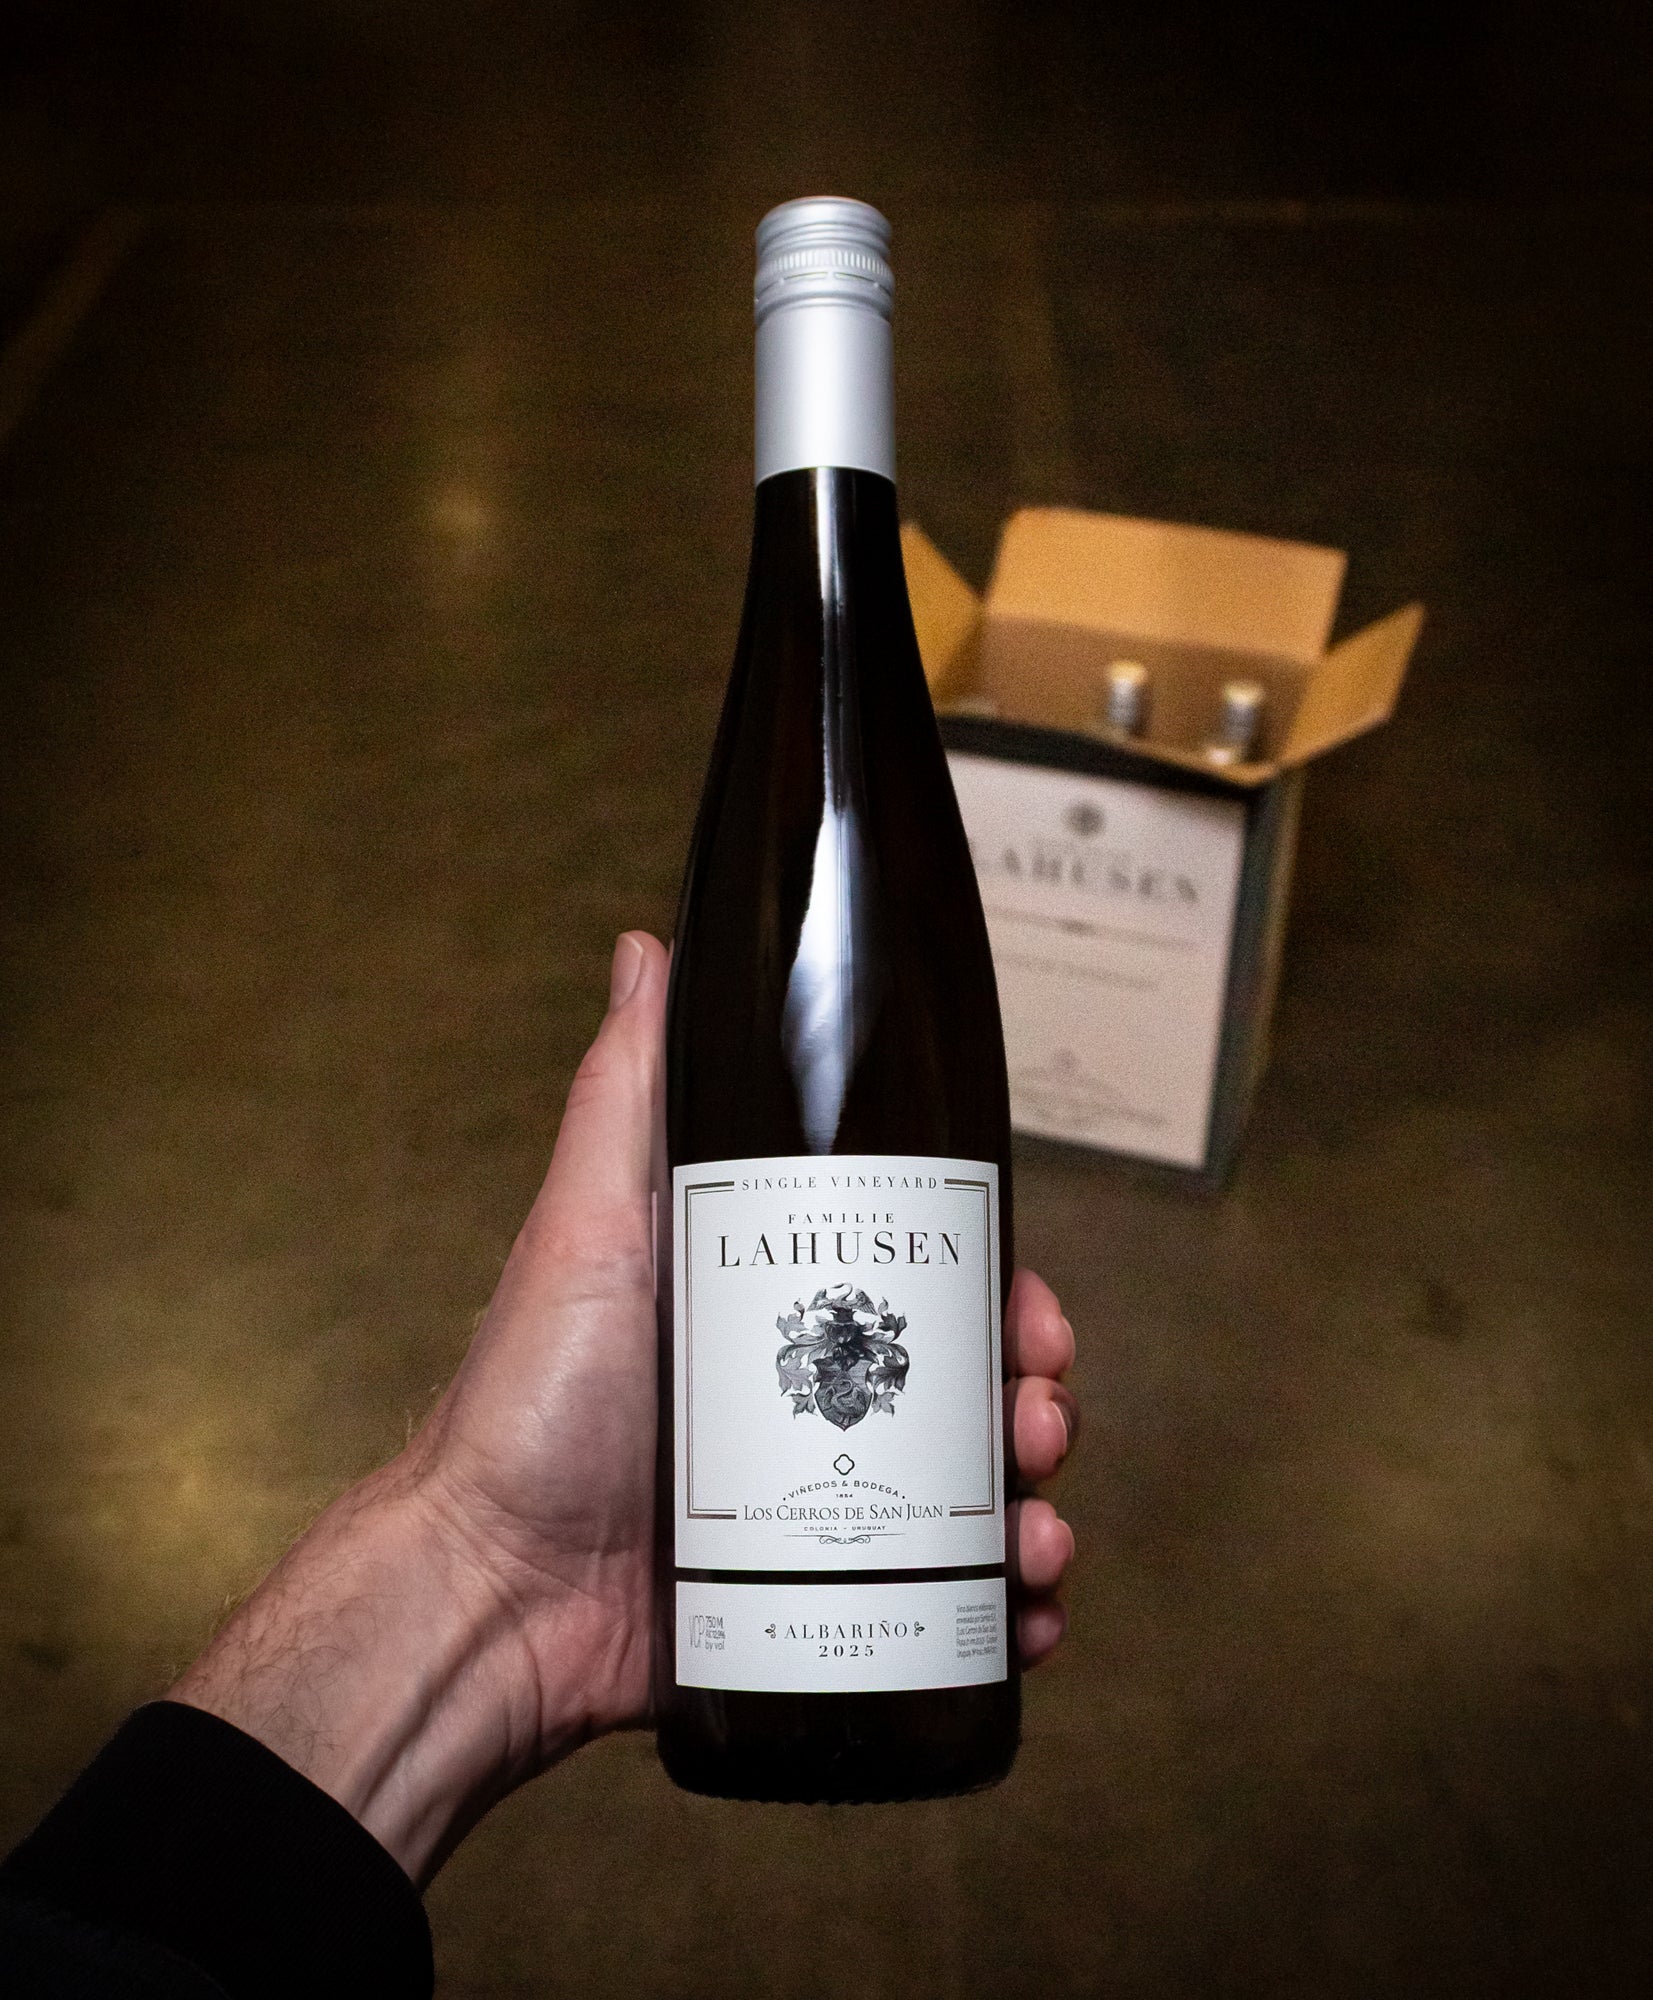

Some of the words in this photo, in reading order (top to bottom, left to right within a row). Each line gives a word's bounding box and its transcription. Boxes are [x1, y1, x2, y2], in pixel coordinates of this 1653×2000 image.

[742, 1177, 817, 1190] SINGLE
[831, 1176, 938, 1189] VINEYARD
[788, 1213, 895, 1224] FAMILIE
[717, 1231, 961, 1268] LAHUSEN
[788, 1480, 838, 1499] VIÑEDOS
[853, 1480, 899, 1497] BODEGA
[743, 1504, 773, 1521] LOS
[776, 1504, 840, 1521] CERROS
[845, 1507, 865, 1520] DE
[869, 1504, 902, 1520] SAN
[906, 1504, 944, 1521] JUAN
[784, 1620, 908, 1639] ALBARIÑO
[818, 1644, 874, 1658] 2025
